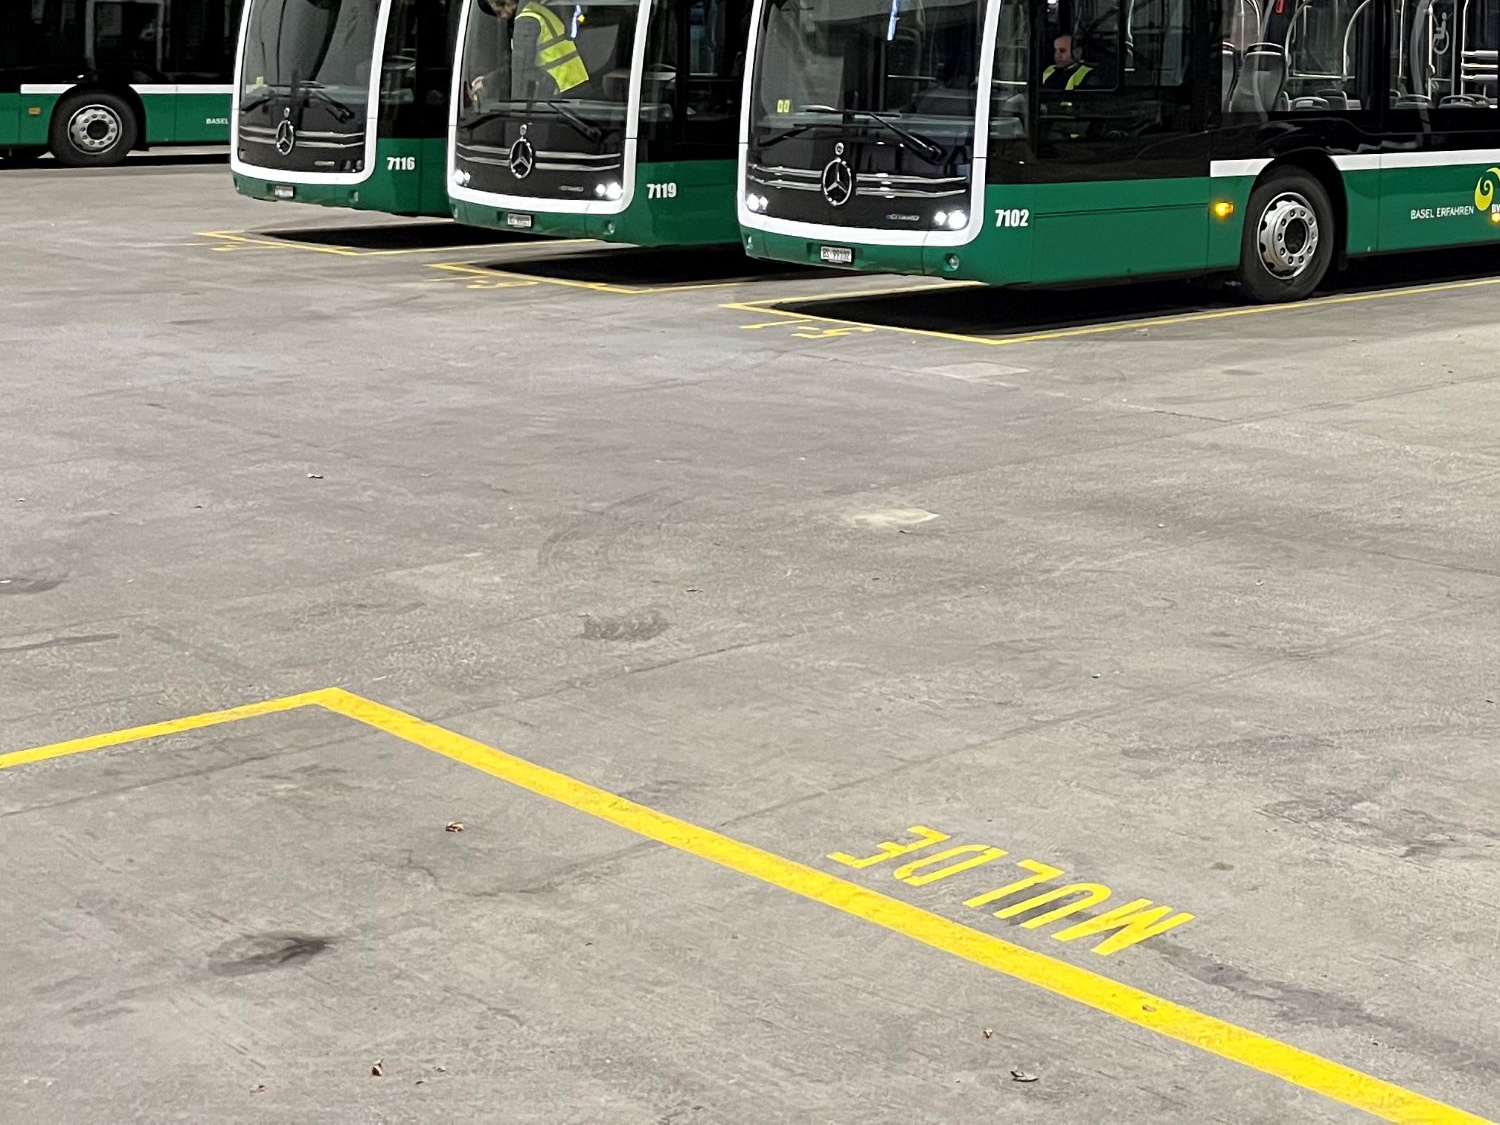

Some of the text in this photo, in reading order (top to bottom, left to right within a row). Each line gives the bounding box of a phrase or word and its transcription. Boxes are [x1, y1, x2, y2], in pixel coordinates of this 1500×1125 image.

[386, 156, 416, 171] 7116
[646, 181, 677, 199] 7119
[994, 208, 1030, 227] 7102
[1410, 205, 1475, 220] BASEL ERFAHREN
[825, 824, 1196, 956] MULDE
